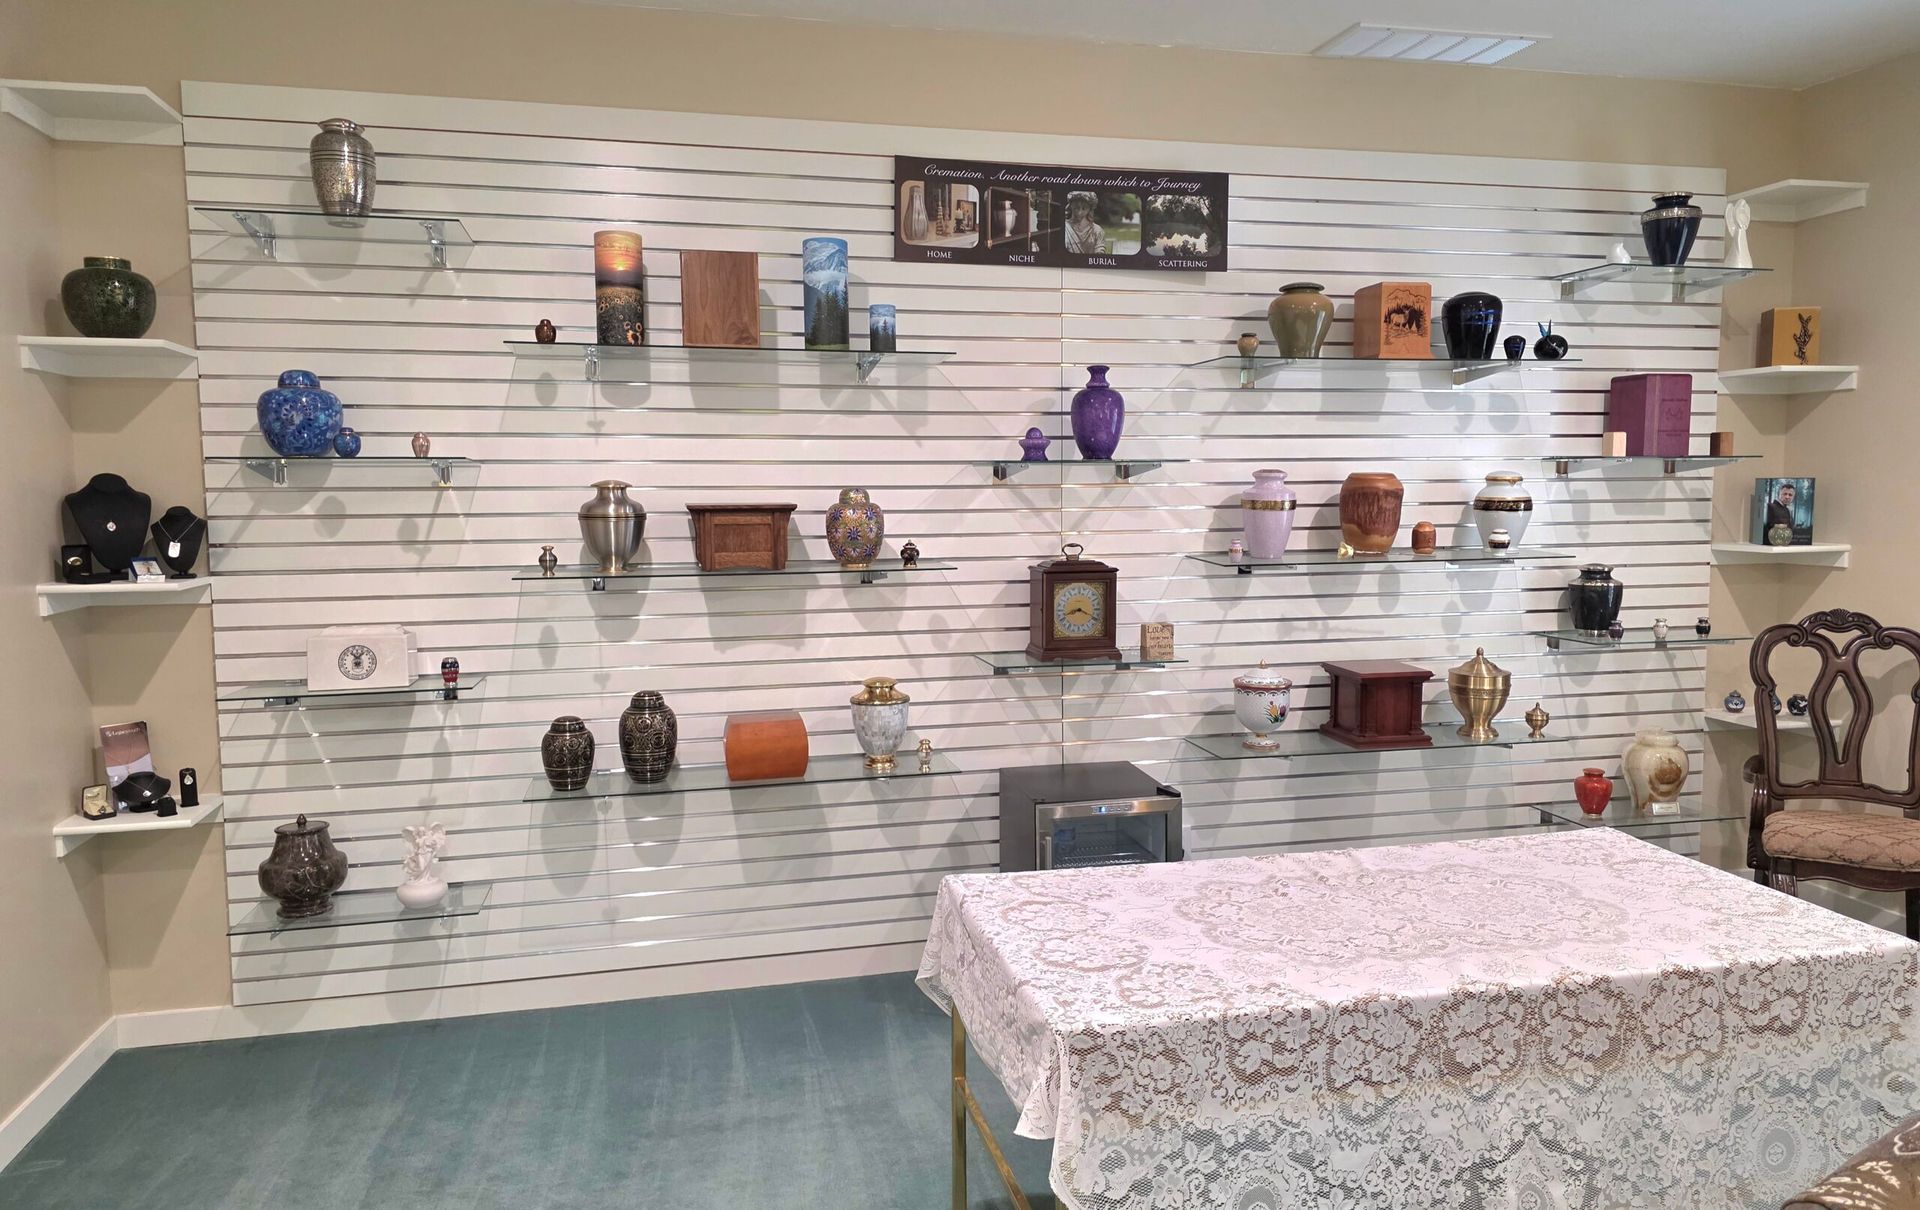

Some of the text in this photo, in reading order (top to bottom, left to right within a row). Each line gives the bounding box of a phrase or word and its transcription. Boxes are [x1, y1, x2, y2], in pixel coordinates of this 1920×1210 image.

[990, 169, 1041, 183] Another
[1041, 173, 1070, 185] road
[1071, 174, 1101, 186] down
[1104, 175, 1140, 188] which
[1140, 179, 1151, 188] to
[1151, 177, 1201, 192] Journey
[927, 250, 953, 259] HOME
[1009, 255, 1036, 263] NICHE
[1088, 258, 1117, 266] BURIAL
[1159, 260, 1208, 268] SCATTERING
